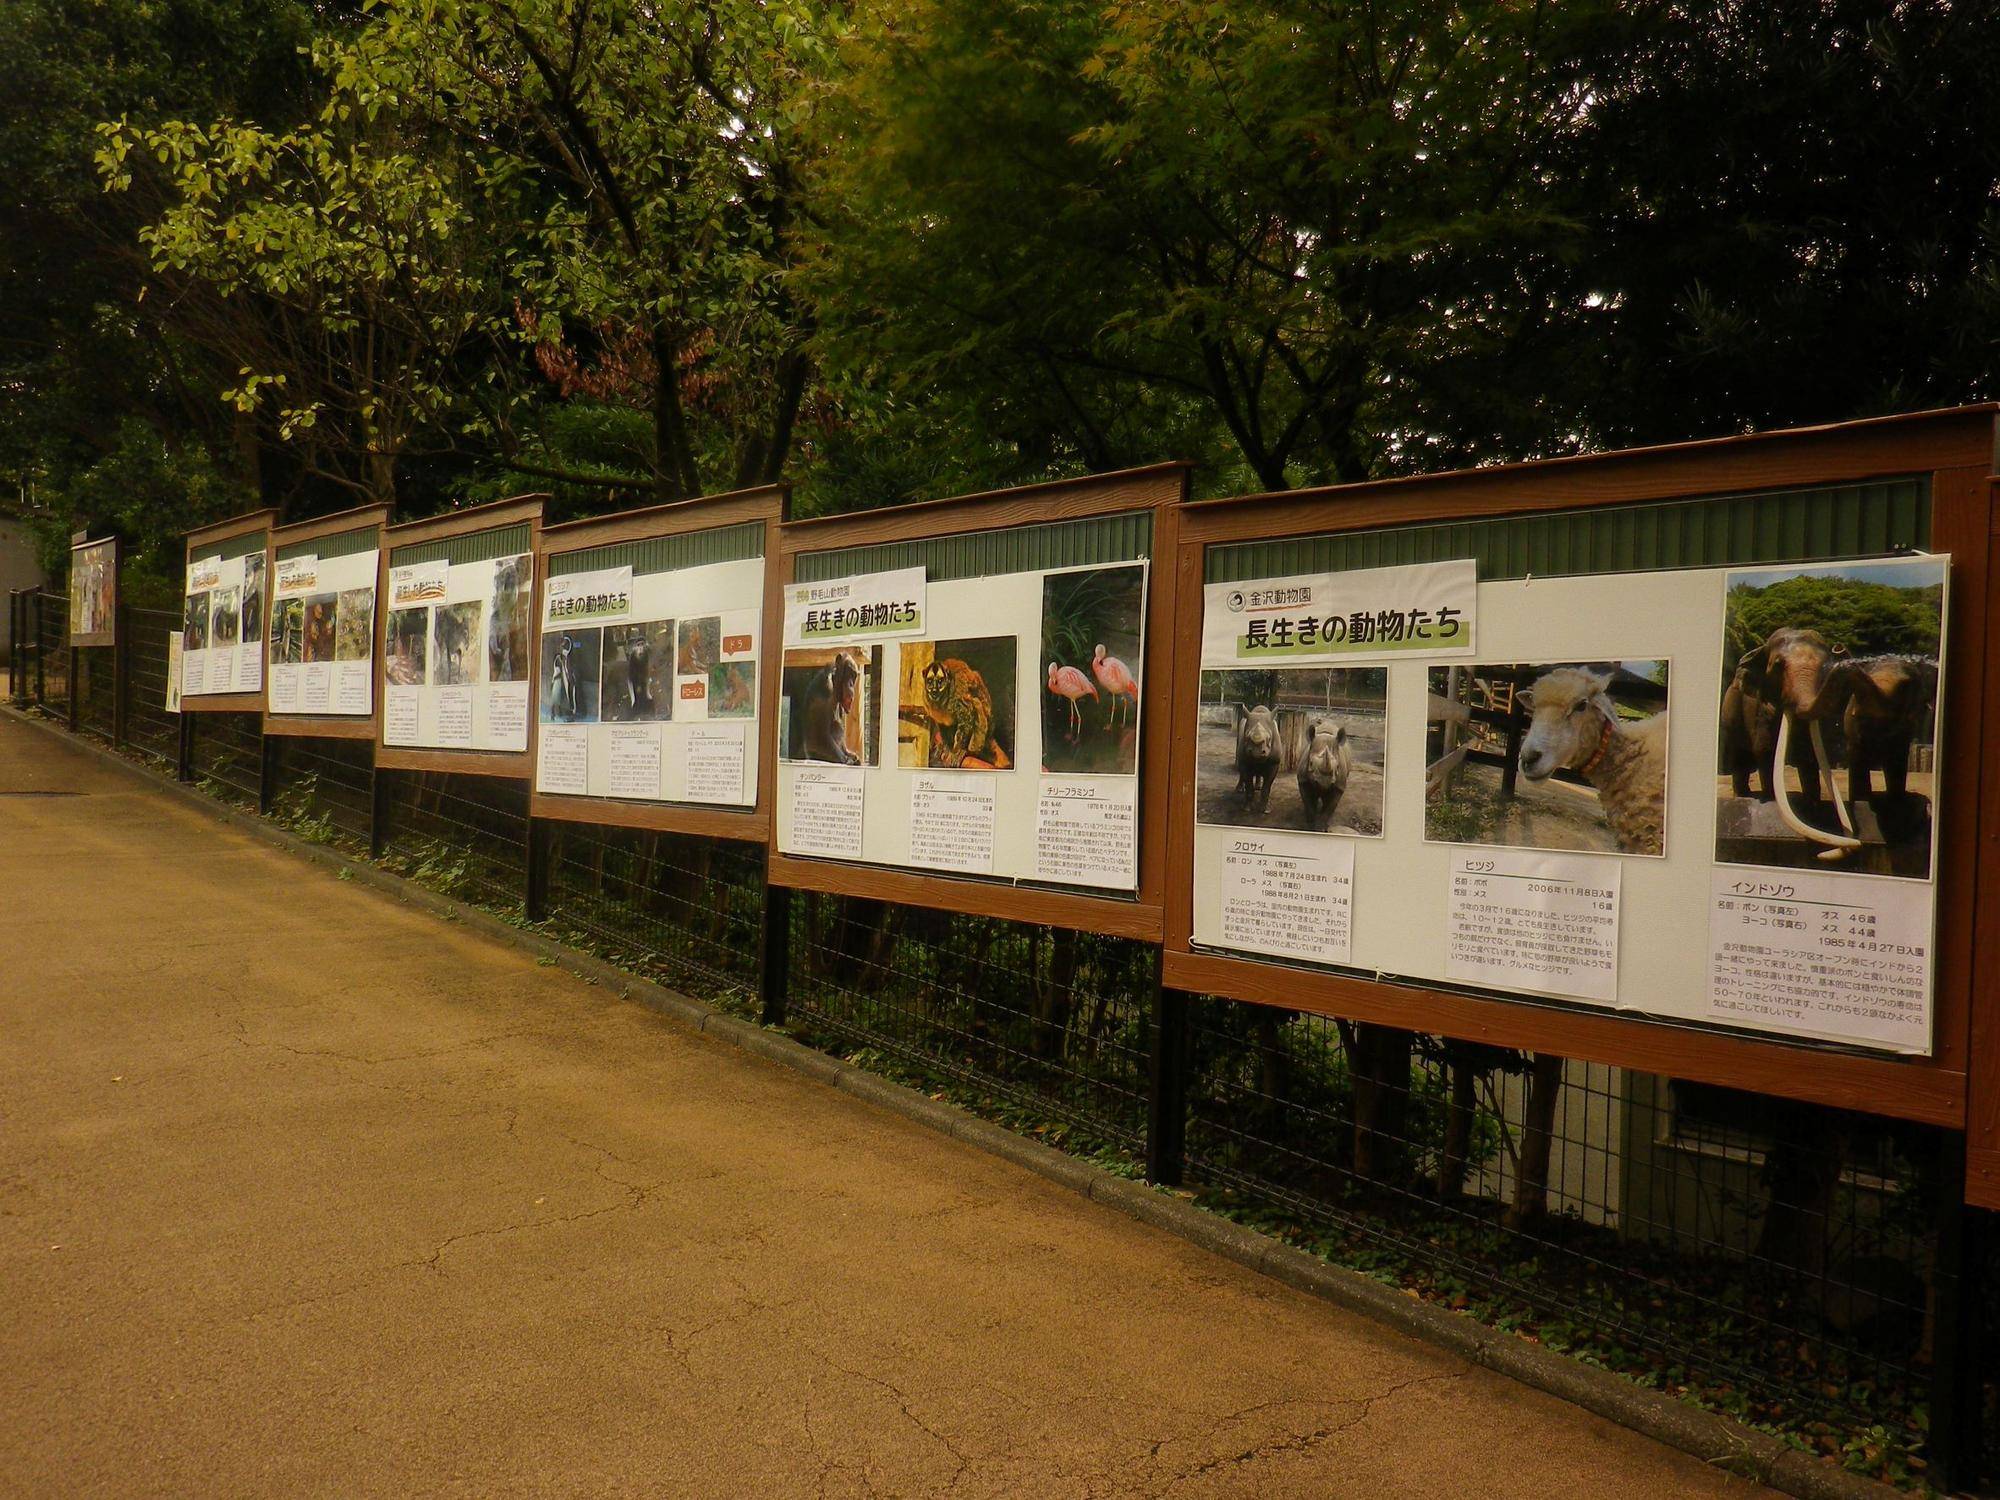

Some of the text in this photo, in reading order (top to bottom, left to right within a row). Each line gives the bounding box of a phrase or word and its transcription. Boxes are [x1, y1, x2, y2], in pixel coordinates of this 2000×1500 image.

[811, 586, 850, 600] 野毛山動物園
[1250, 587, 1312, 606] 金沢動物園
[550, 592, 628, 617] 長生きの動物たち
[806, 600, 917, 632] 長生きの動物たち
[1245, 606, 1461, 649] 長生きの動物たち
[1047, 785, 1094, 798] チリーフラミンゴ
[1234, 841, 1264, 852] クロサイ
[1465, 859, 1494, 872] ヒツジ
[1240, 877, 1256, 885] ローラ
[1262, 869, 1349, 884] 1988年7月24日生まれ 34歳
[1527, 883, 1613, 899] 2006年11月8日入園
[1731, 880, 1794, 898] インドゾウ
[1331, 896, 1348, 905] 34歳
[1453, 887, 1612, 911] 性別：メス 16歳
[1820, 910, 1840, 921] オス
[1848, 913, 1876, 925] 46歳
[1820, 923, 1838, 934] メス
[1847, 926, 1876, 938] 44歳
[1818, 936, 1925, 958] 1985年4月27日入園
